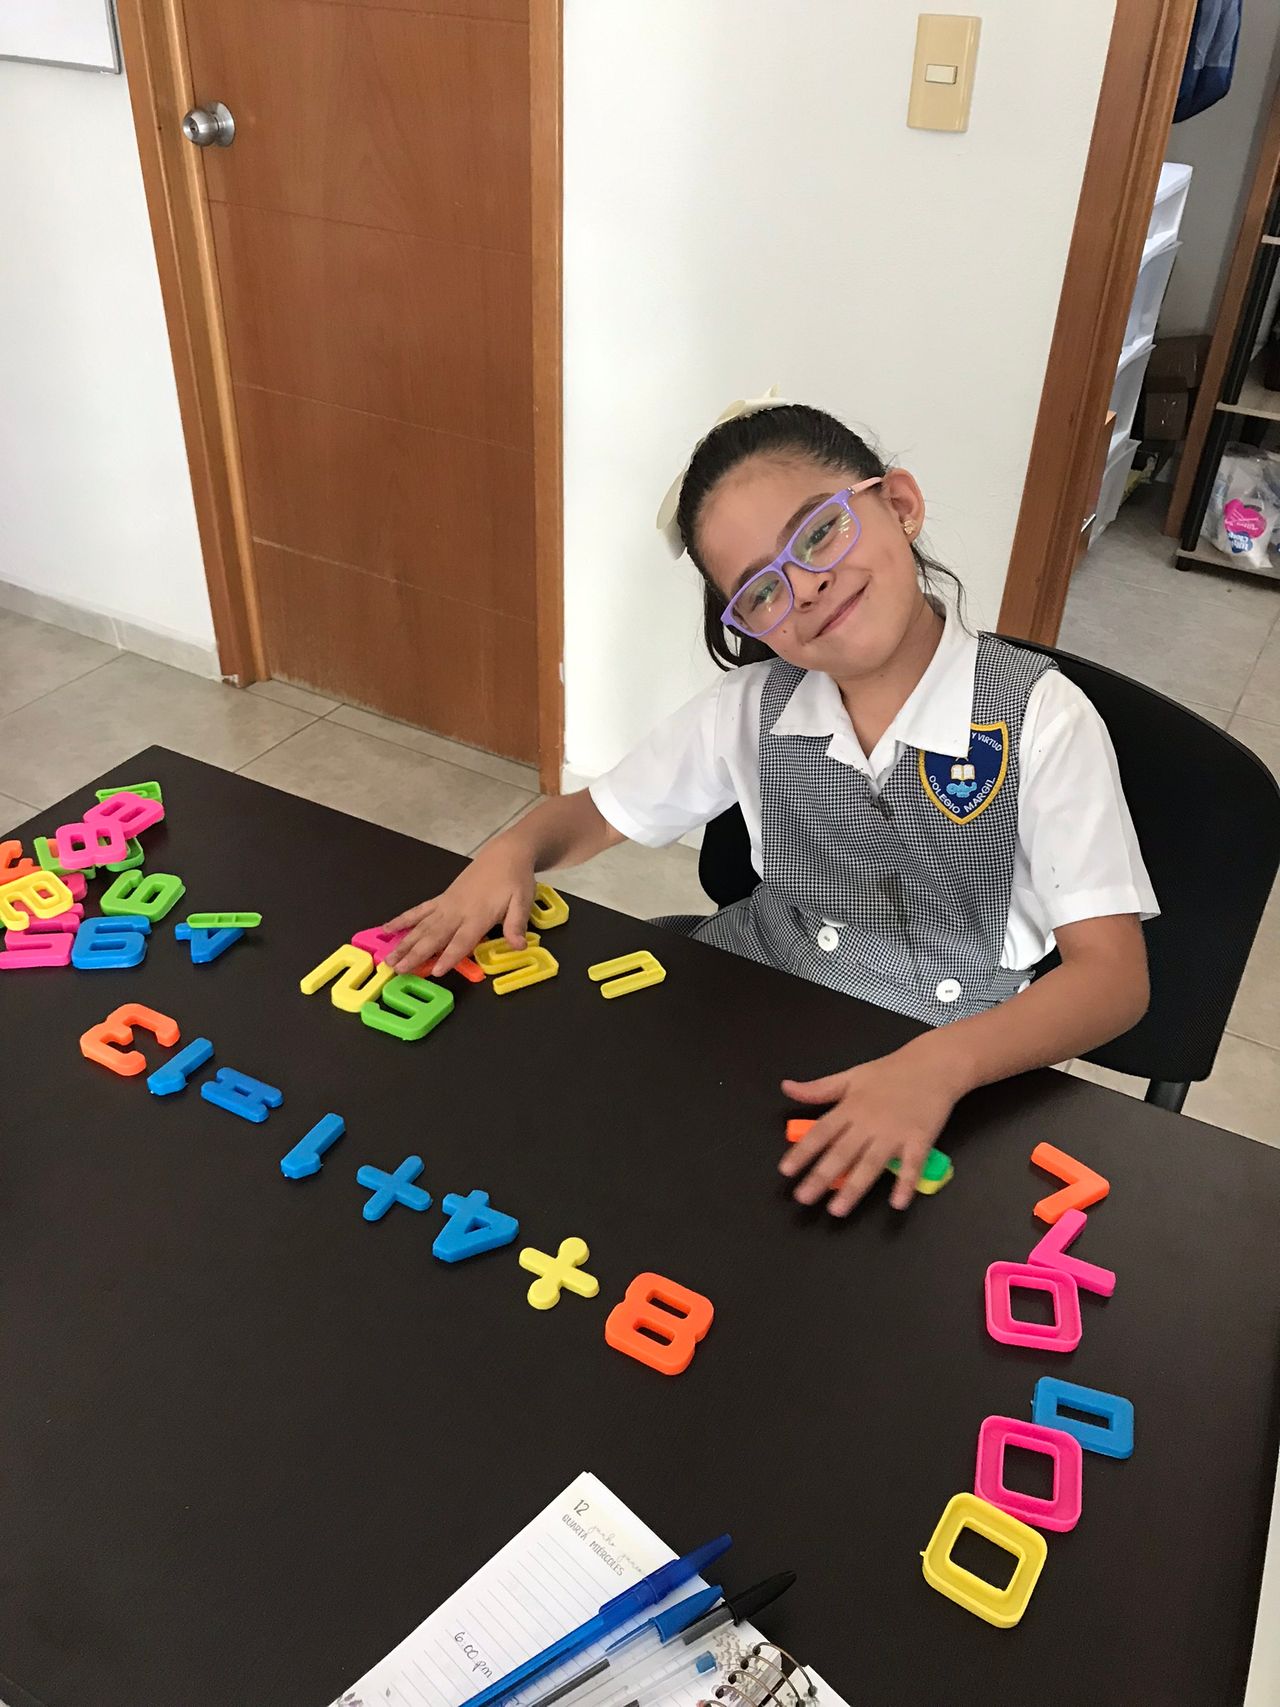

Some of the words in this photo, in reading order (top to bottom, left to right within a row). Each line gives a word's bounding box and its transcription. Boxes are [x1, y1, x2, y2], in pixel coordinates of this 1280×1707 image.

[977, 732, 1002, 752] VIRTUD
[929, 775, 961, 814] COLEGIO
[963, 777, 996, 813] MARGIL
[573, 1499, 590, 1517] 12
[562, 1514, 588, 1541] QUARTA
[588, 1540, 625, 1577] MIÉRCOLES
[471, 1660, 493, 1679] pm
